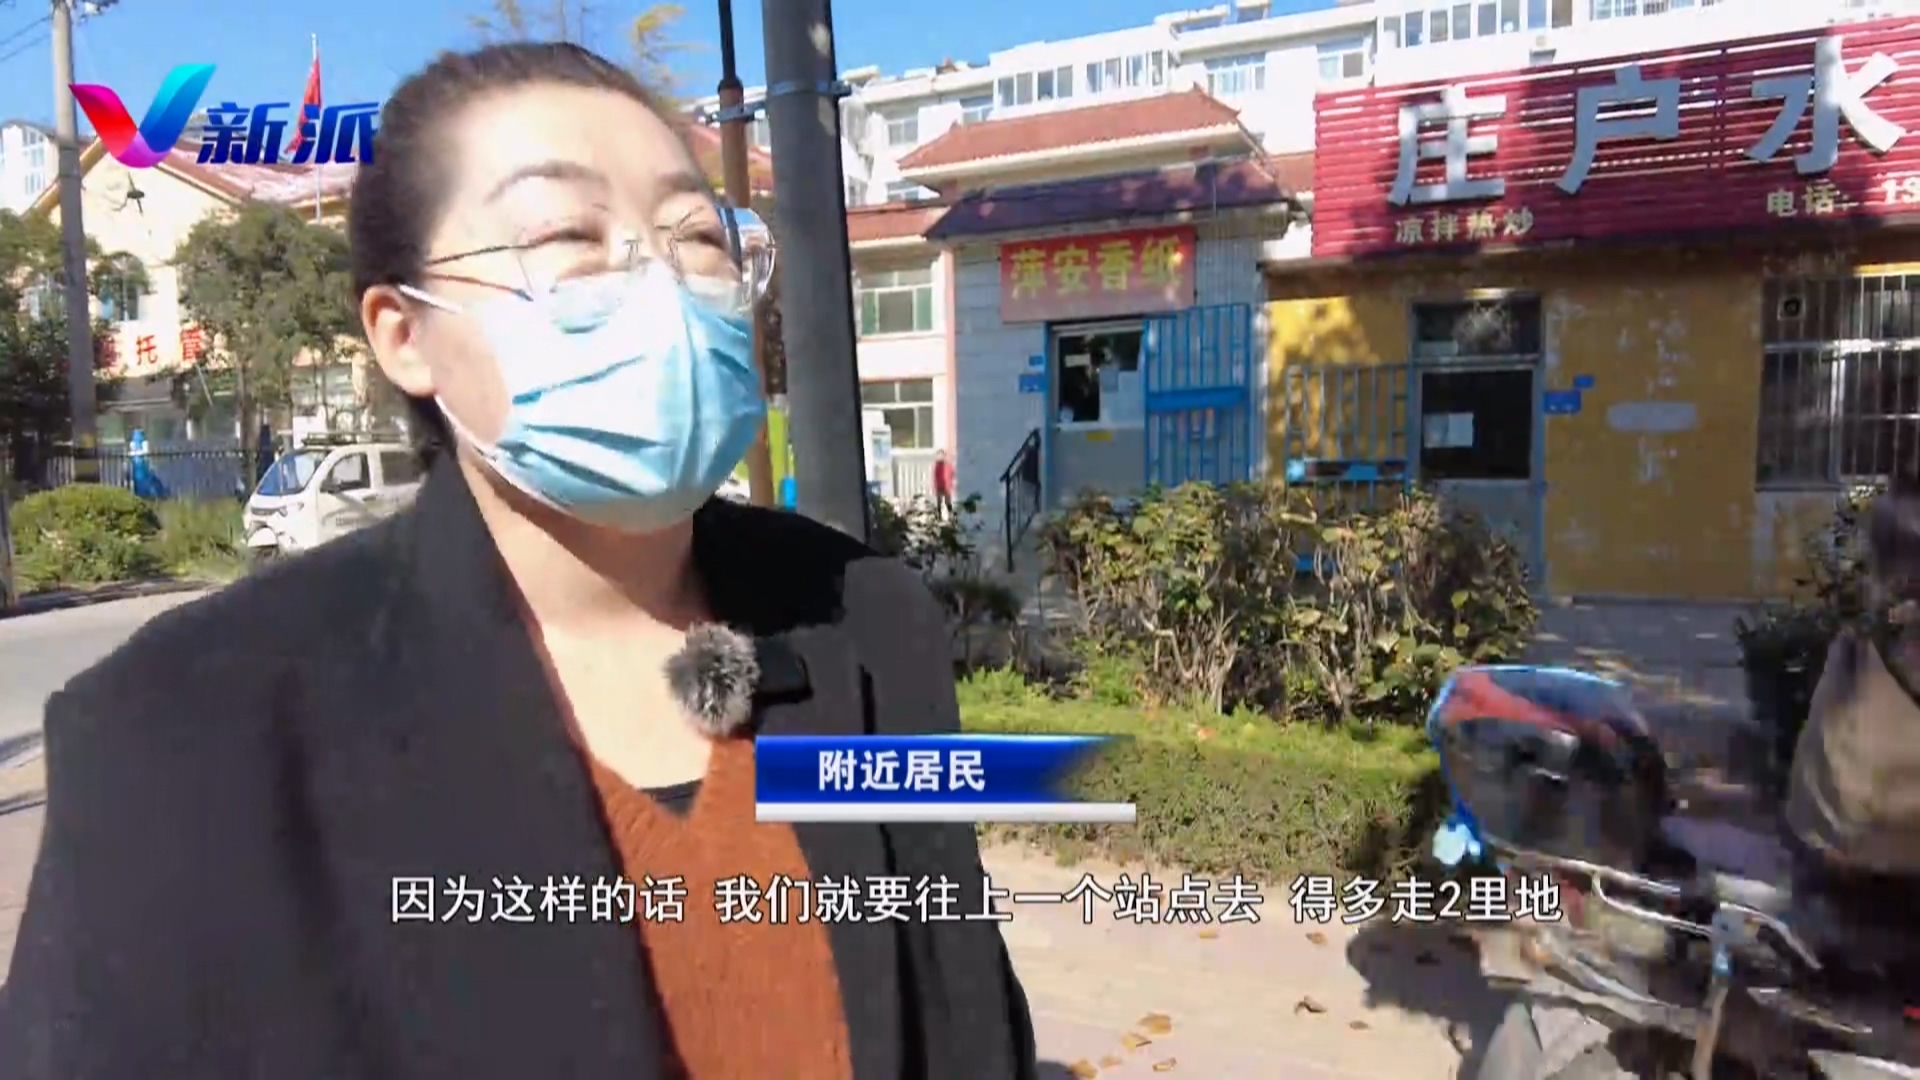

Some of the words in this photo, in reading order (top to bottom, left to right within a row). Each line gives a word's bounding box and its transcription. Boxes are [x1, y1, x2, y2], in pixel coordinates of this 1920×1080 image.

[1387, 37, 1904, 206] 庄户水
[1394, 207, 1534, 244] 凉拌热炒
